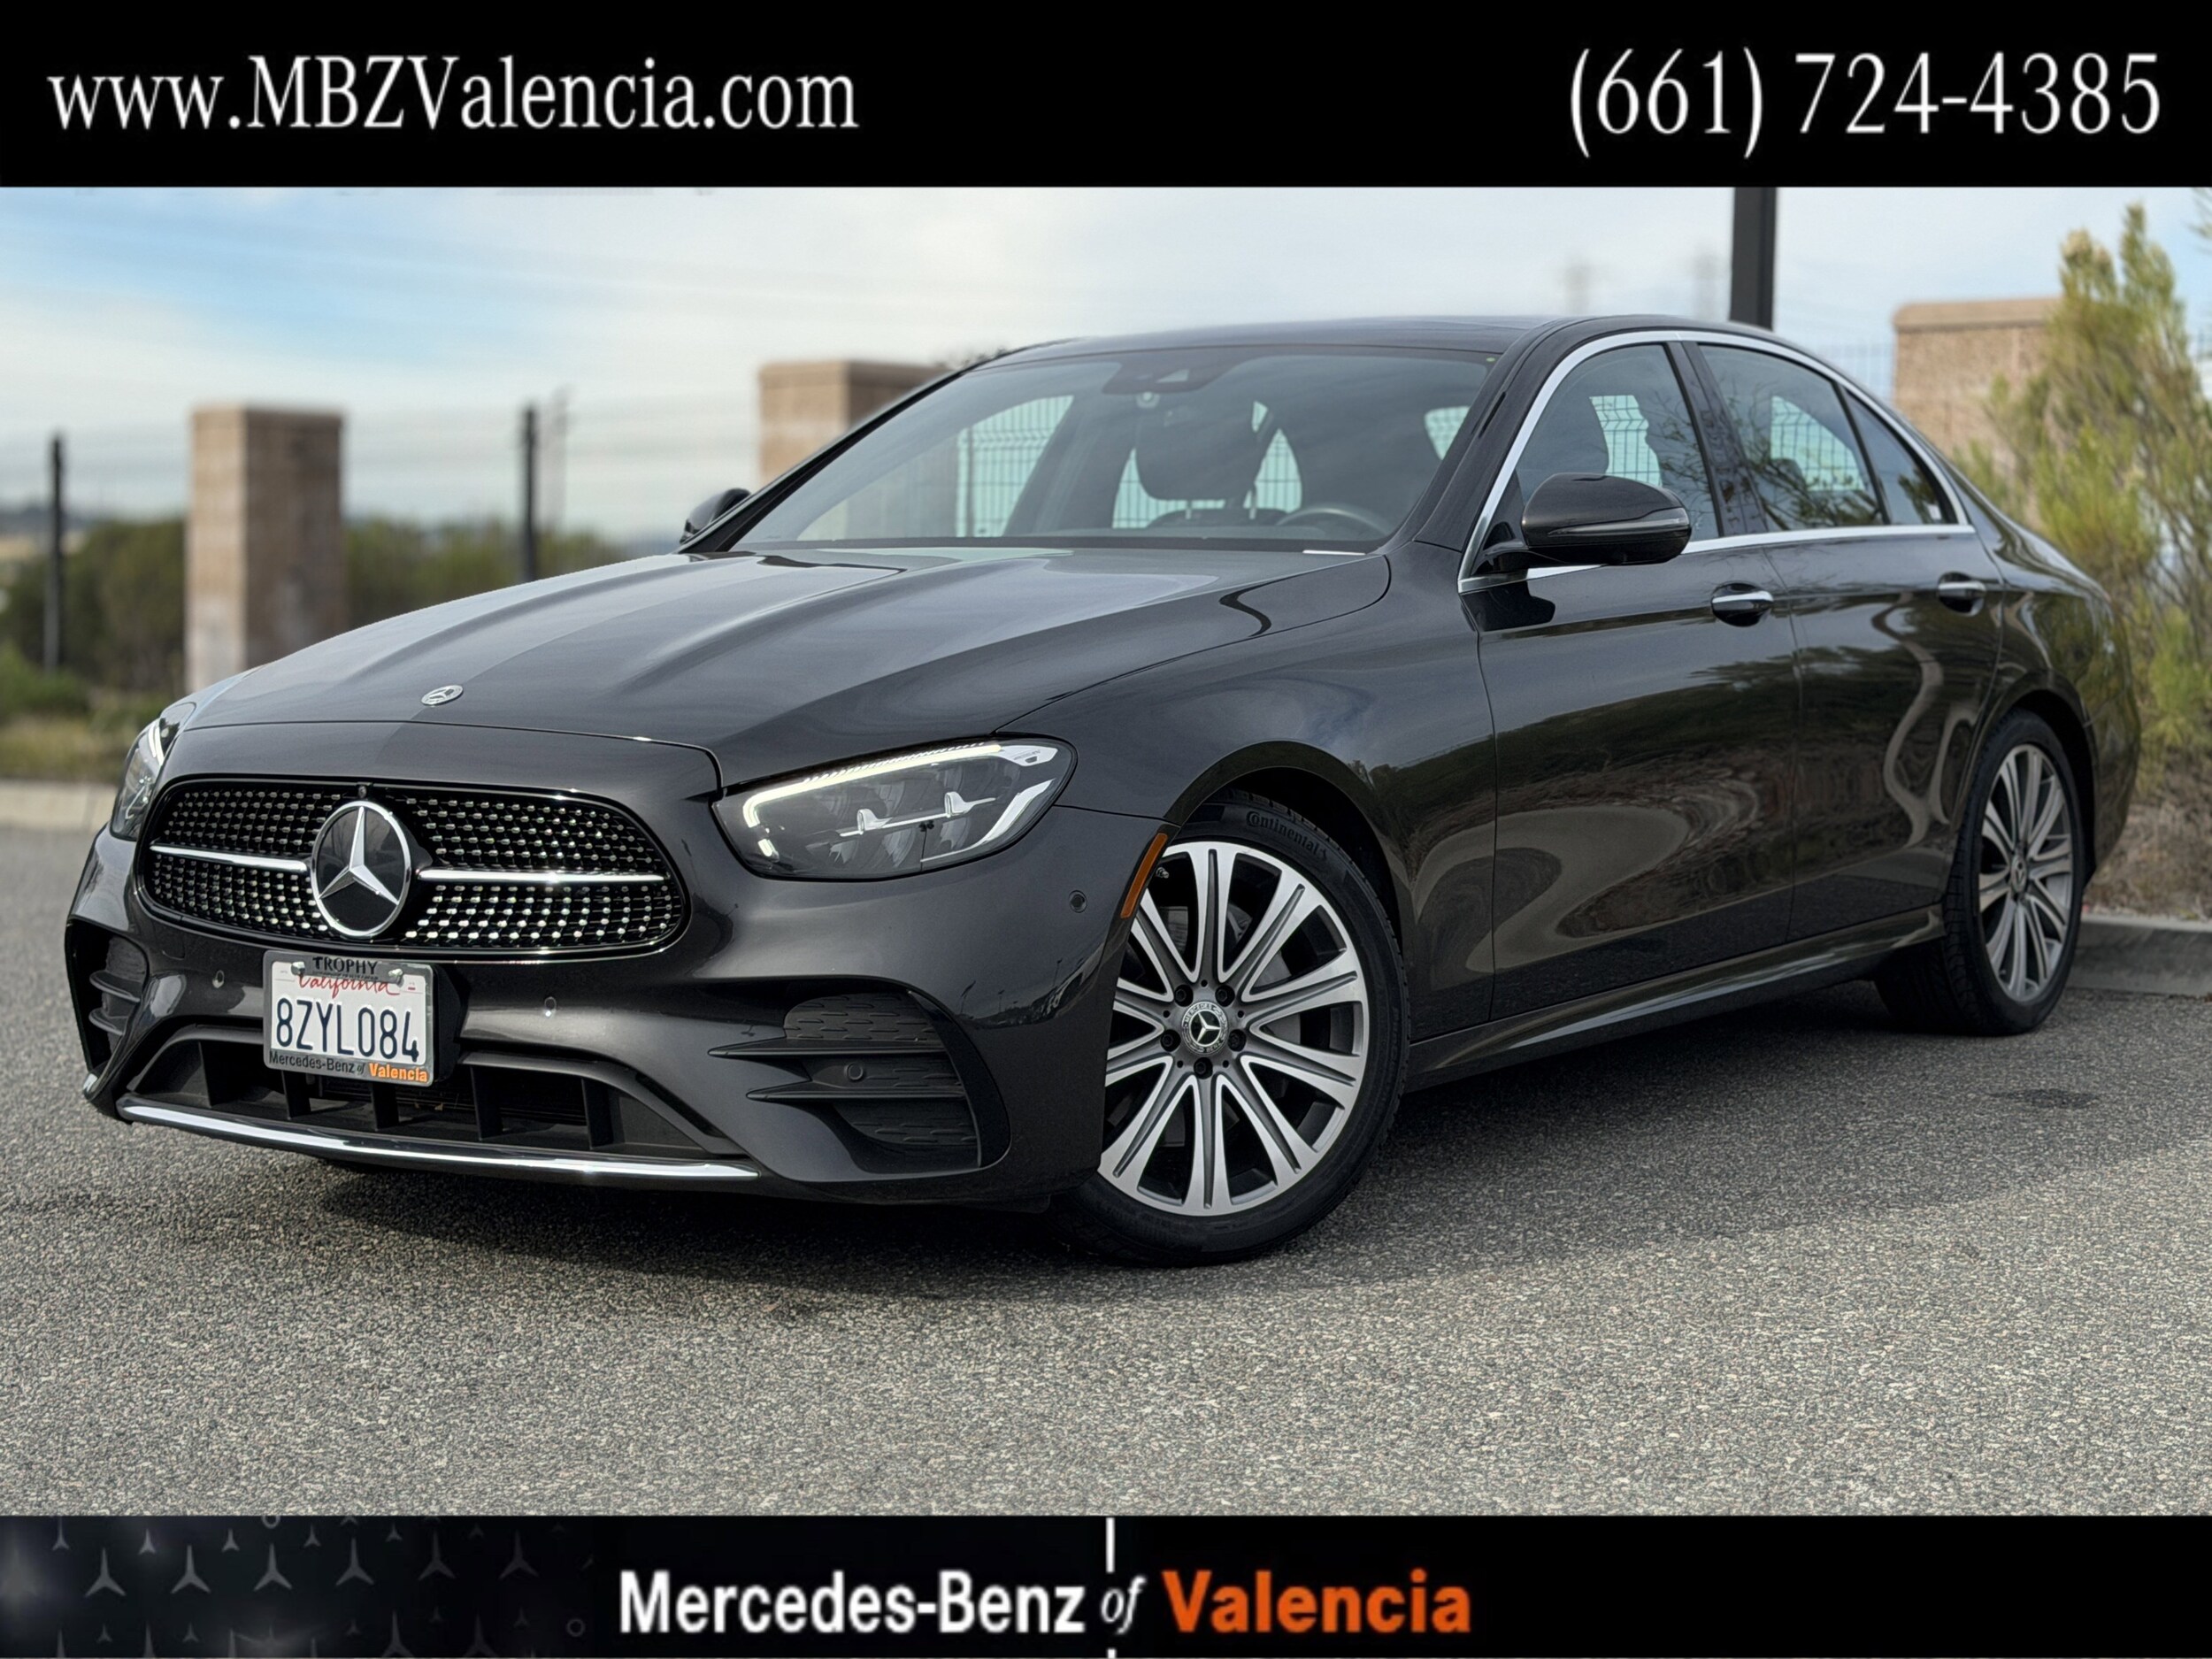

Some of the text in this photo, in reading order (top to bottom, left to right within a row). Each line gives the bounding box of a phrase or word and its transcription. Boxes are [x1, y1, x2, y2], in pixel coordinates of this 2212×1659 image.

[1246, 810, 1319, 856] Continental
[312, 956, 378, 975] TROPHY
[276, 997, 419, 1063] 8ZYL084
[269, 1051, 427, 1082] Mercedes-Benz of Valencia
